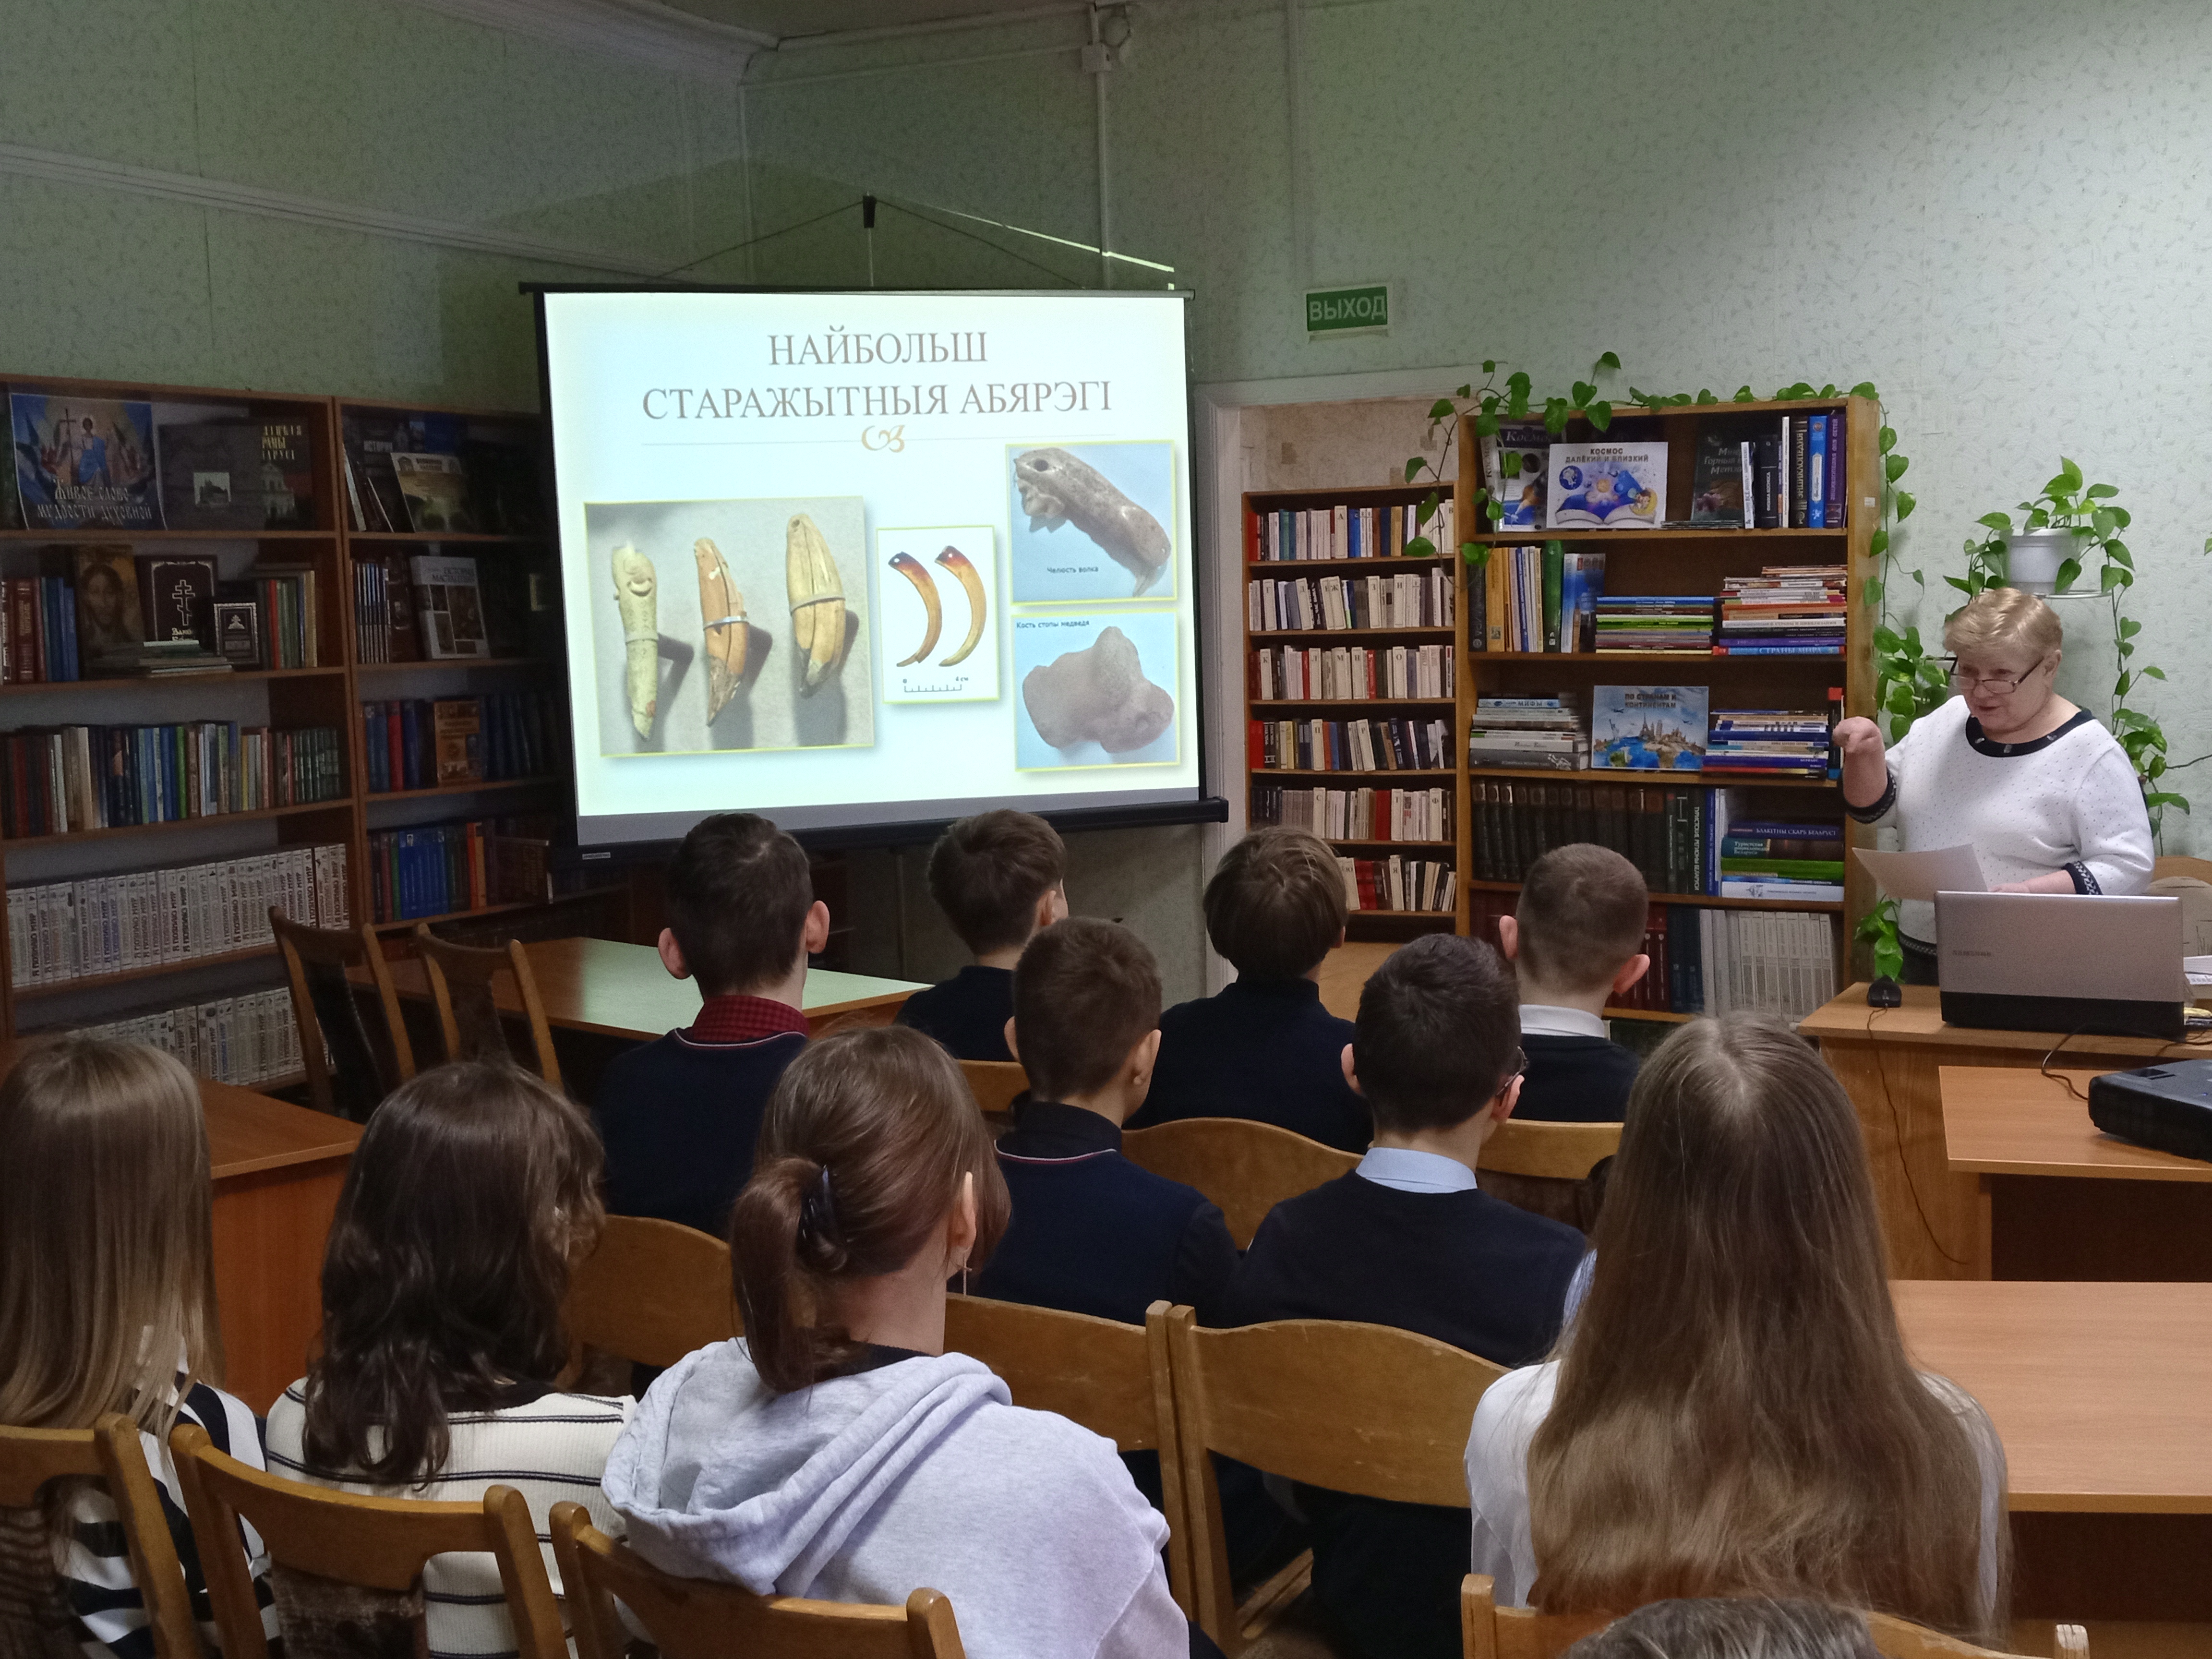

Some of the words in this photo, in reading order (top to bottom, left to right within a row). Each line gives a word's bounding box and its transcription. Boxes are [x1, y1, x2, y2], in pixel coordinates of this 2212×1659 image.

[1309, 295, 1387, 321] ВЫХОД
[769, 325, 986, 365] НАЙБОЛЬШ
[643, 385, 948, 420] СТАРАЖЫТНЫЯ
[961, 381, 1110, 413] АБЯРЭГІ
[1565, 455, 1601, 463] ДАЛЁКИЙ
[229, 879, 238, 897] МИР
[171, 910, 179, 944] ПОЗНАЮ
[181, 907, 190, 944] ПОЗНАЮ
[231, 899, 240, 935] ПОЗНАЮ
[30, 933, 39, 969] ПОЗНАЮ
[102, 920, 110, 955] ПОЗНАЮ
